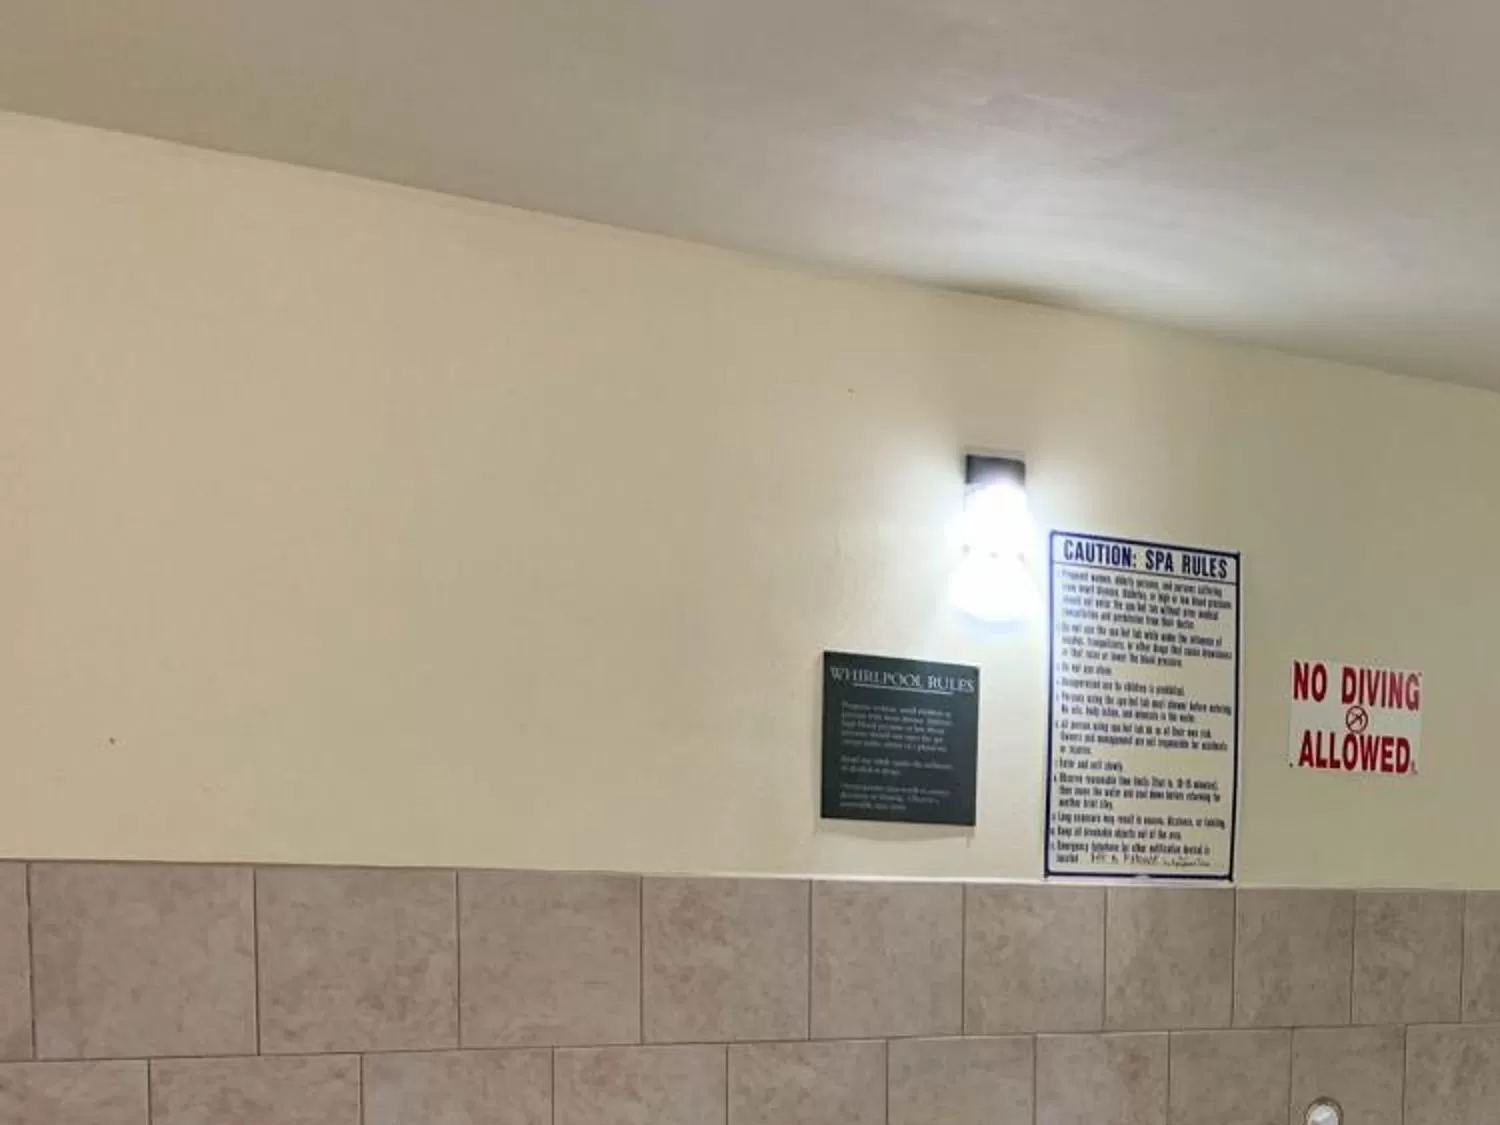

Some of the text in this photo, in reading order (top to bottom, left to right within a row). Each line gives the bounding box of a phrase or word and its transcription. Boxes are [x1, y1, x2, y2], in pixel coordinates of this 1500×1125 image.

[1064, 539, 1228, 579] CAUTION: SPA RULES
[830, 667, 976, 693] WHIRLPOOL RULES
[1294, 661, 1419, 711] NO DIVING
[1299, 729, 1410, 774] ALLOWED
